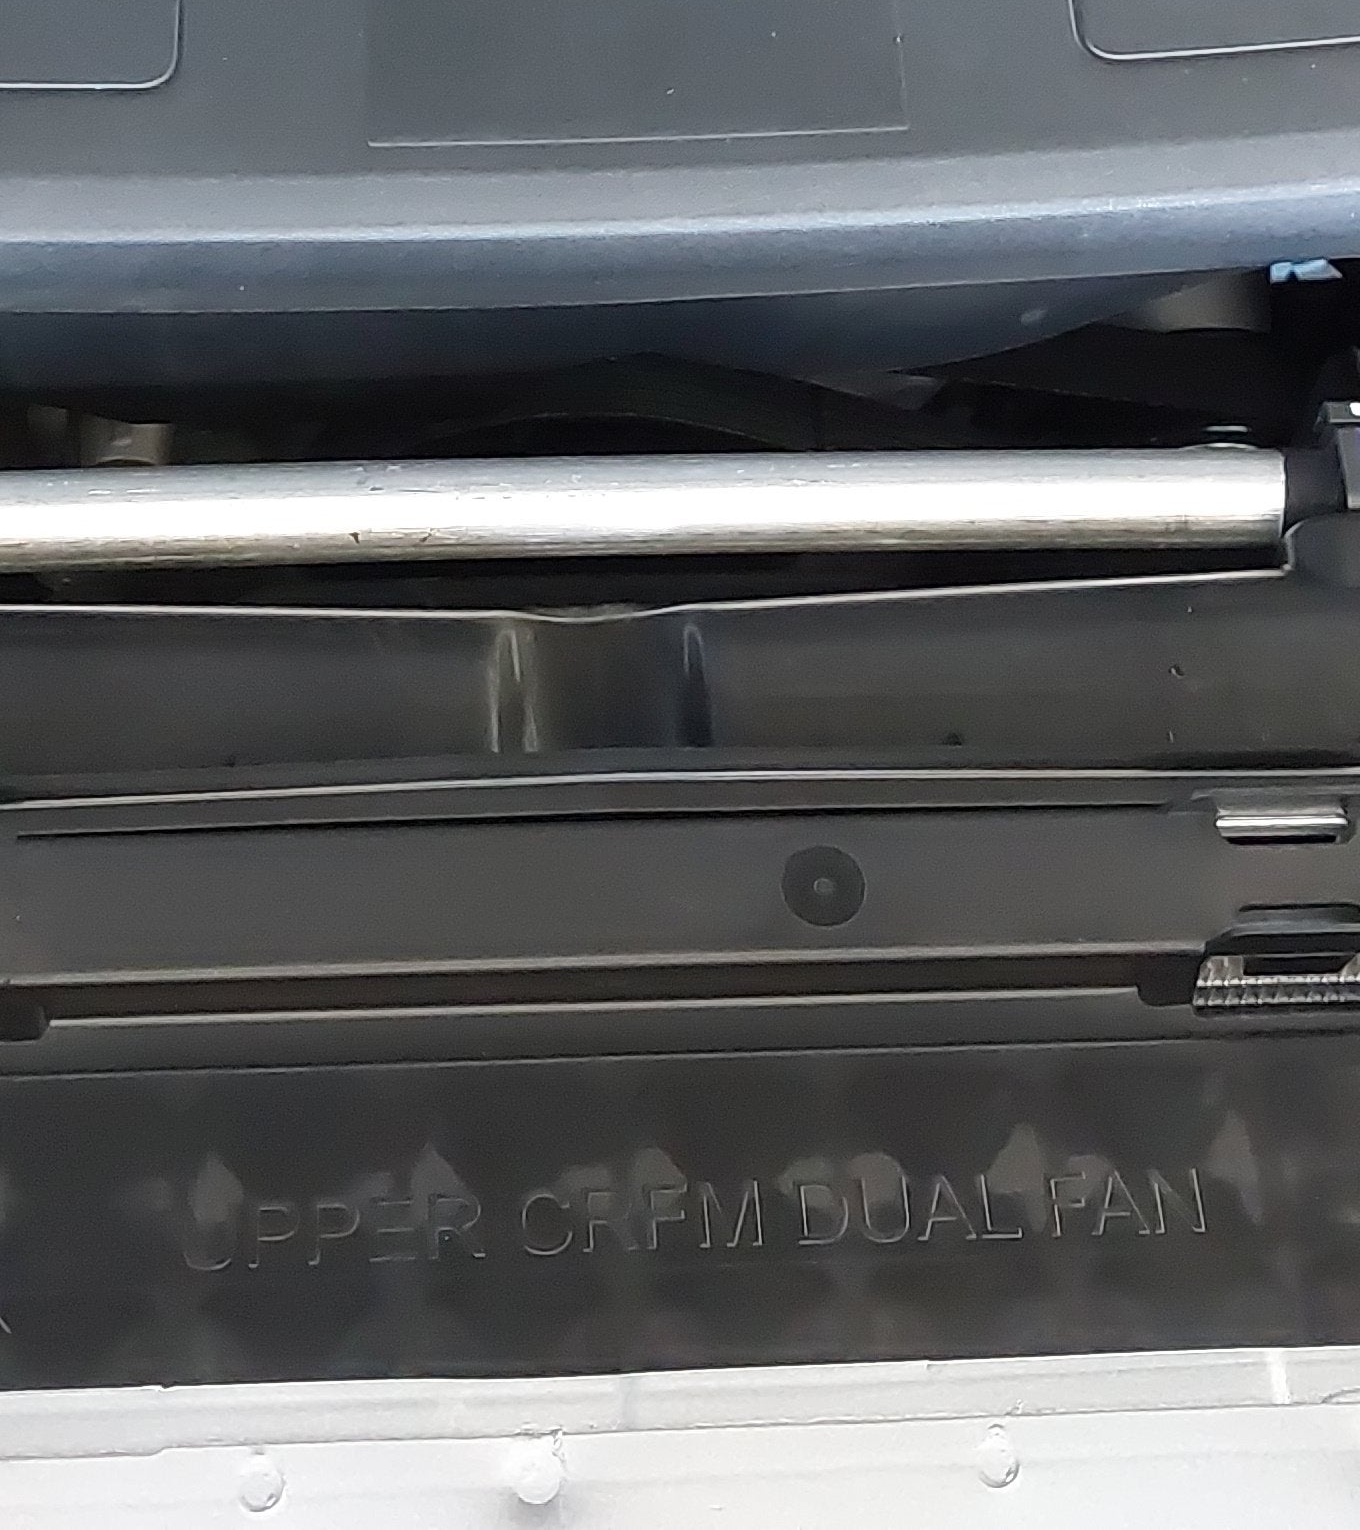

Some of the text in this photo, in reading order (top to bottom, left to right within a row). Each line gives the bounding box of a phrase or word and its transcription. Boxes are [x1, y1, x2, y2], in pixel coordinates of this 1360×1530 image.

[183, 1192, 486, 1271] UPPER
[798, 1173, 1023, 1246] DUAL
[1051, 1168, 1206, 1238] FAN
